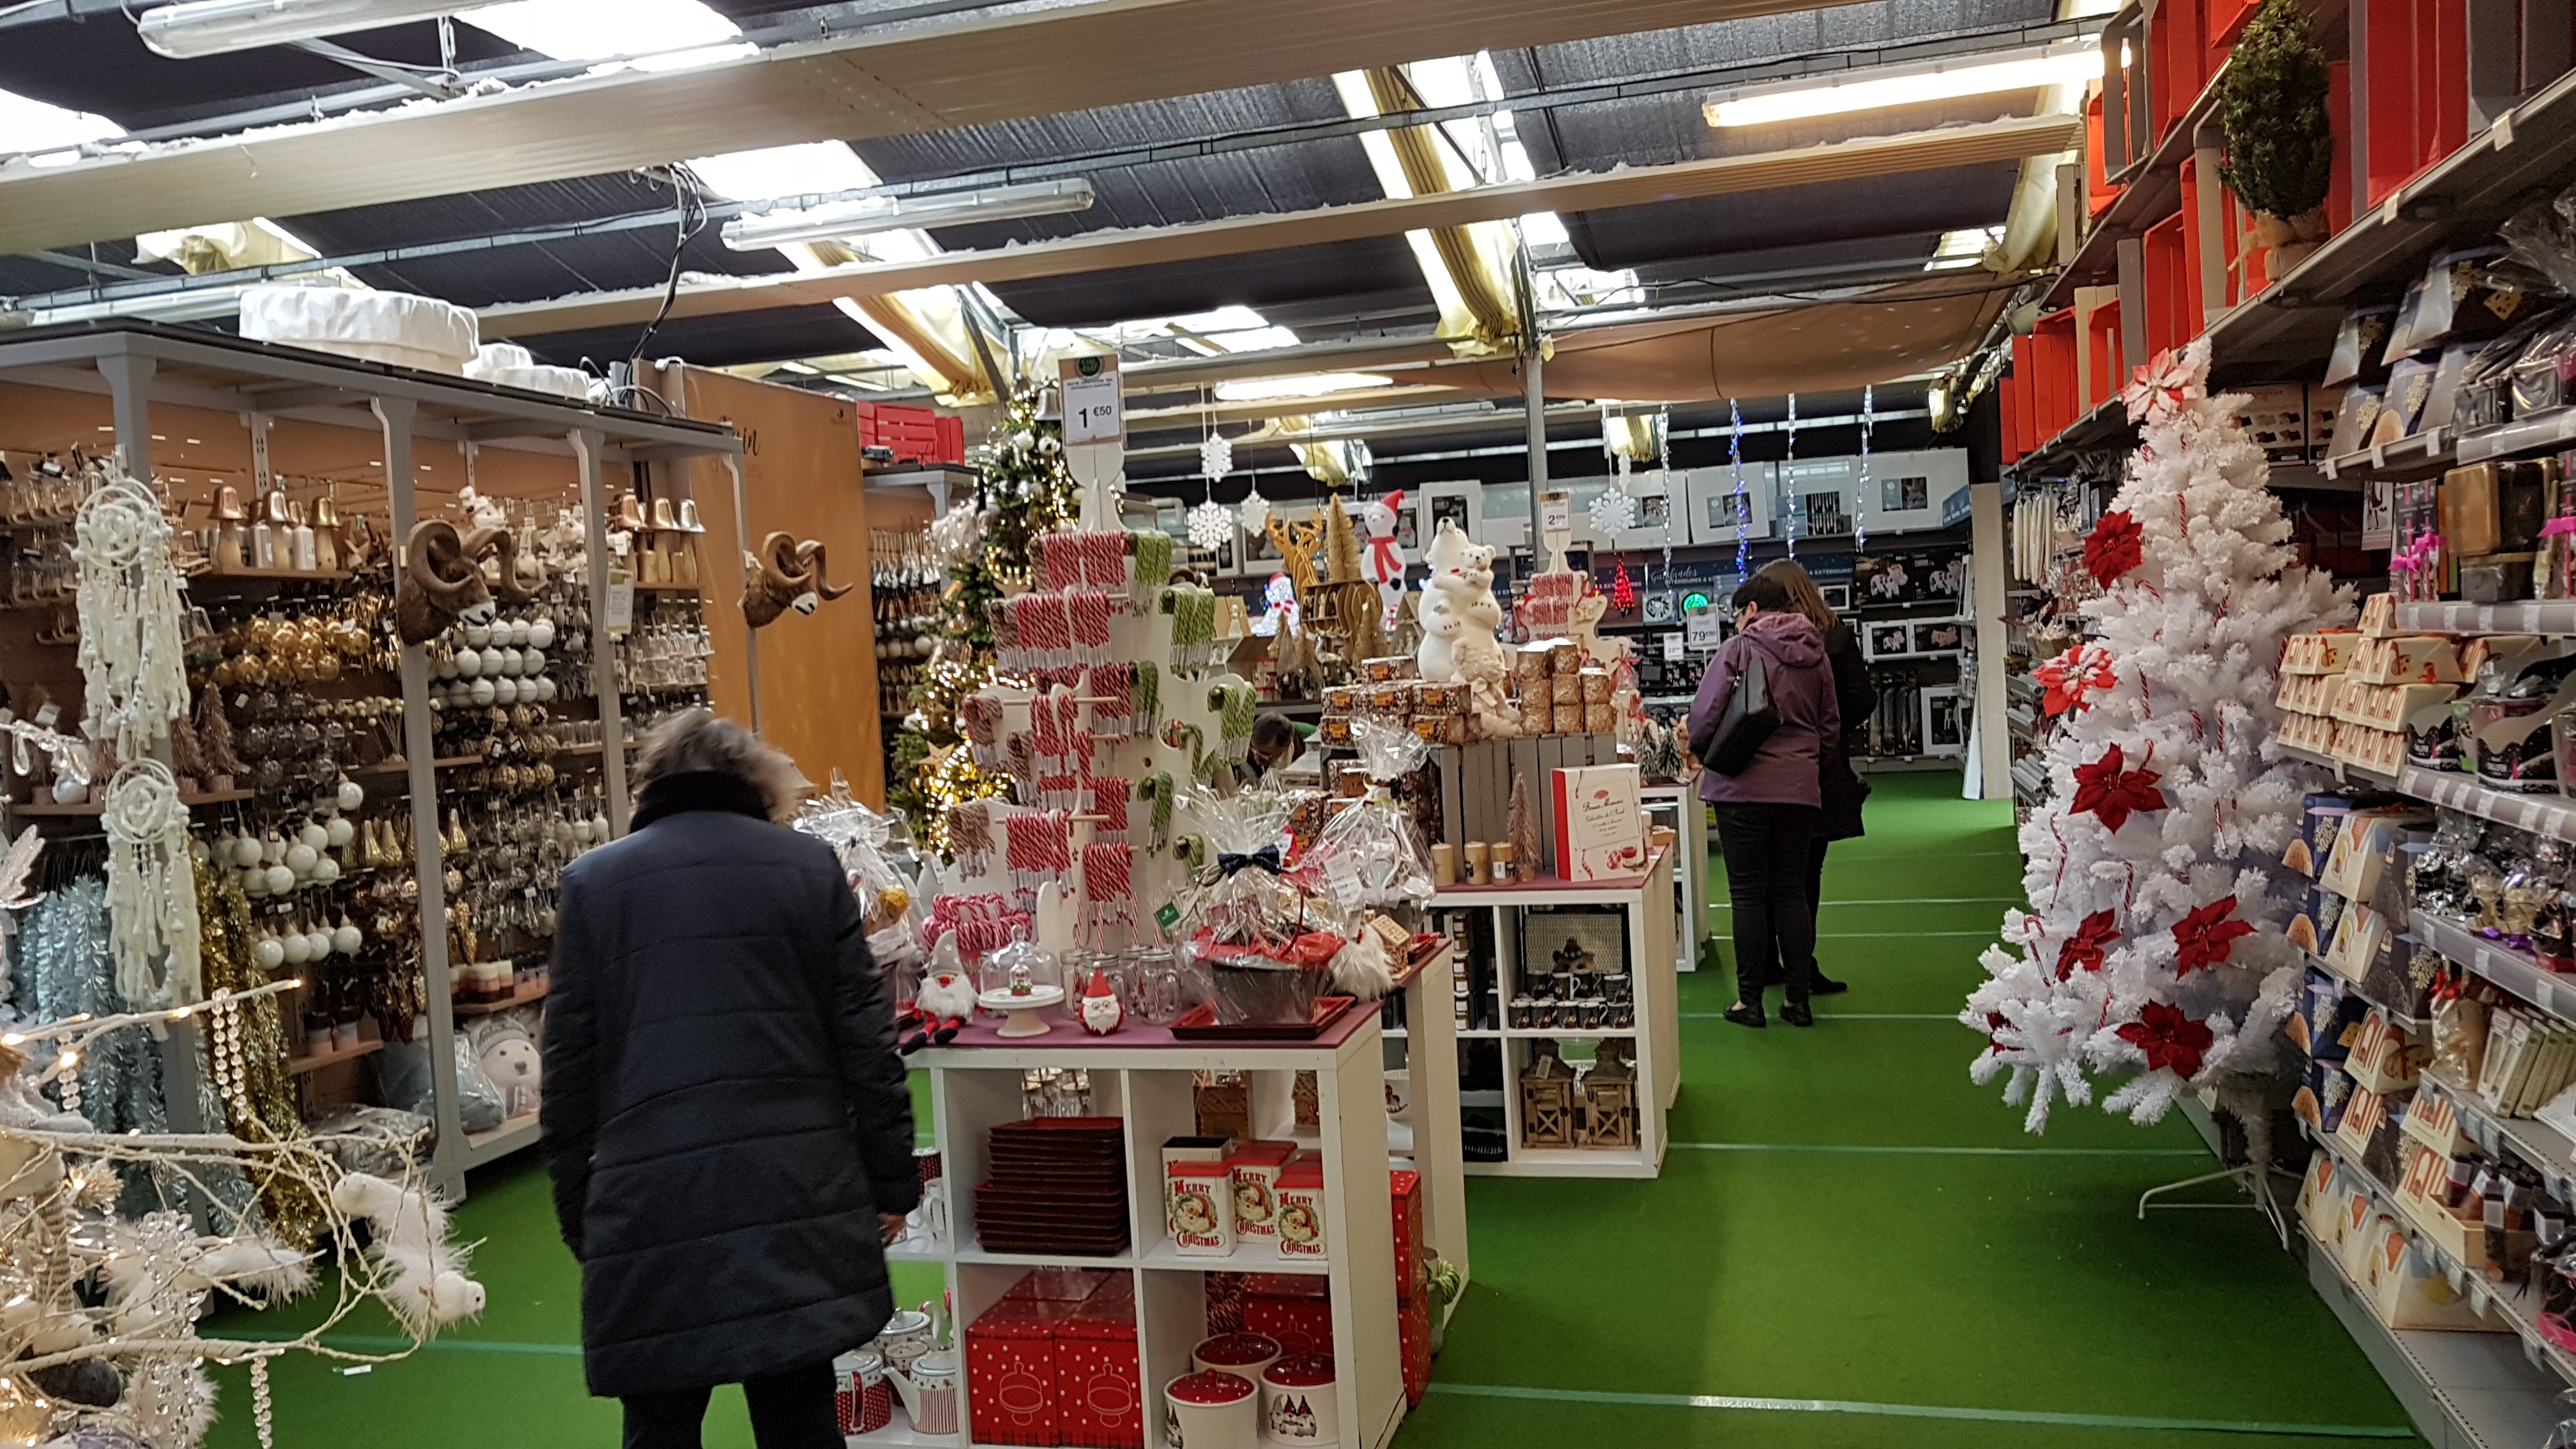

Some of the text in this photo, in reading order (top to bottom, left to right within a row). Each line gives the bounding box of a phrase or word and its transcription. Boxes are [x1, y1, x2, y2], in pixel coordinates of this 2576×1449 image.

[1078, 408, 1087, 429] 1
[1231, 1167, 1268, 1184] MERRY
[1174, 1179, 1211, 1197] MERRY
[1278, 1192, 1314, 1208] MERRY
[1235, 1218, 1275, 1236] CHRISTMAS
[1176, 1231, 1220, 1248] CHRISTMAS
[1280, 1240, 1321, 1255] CHRISTMAS
